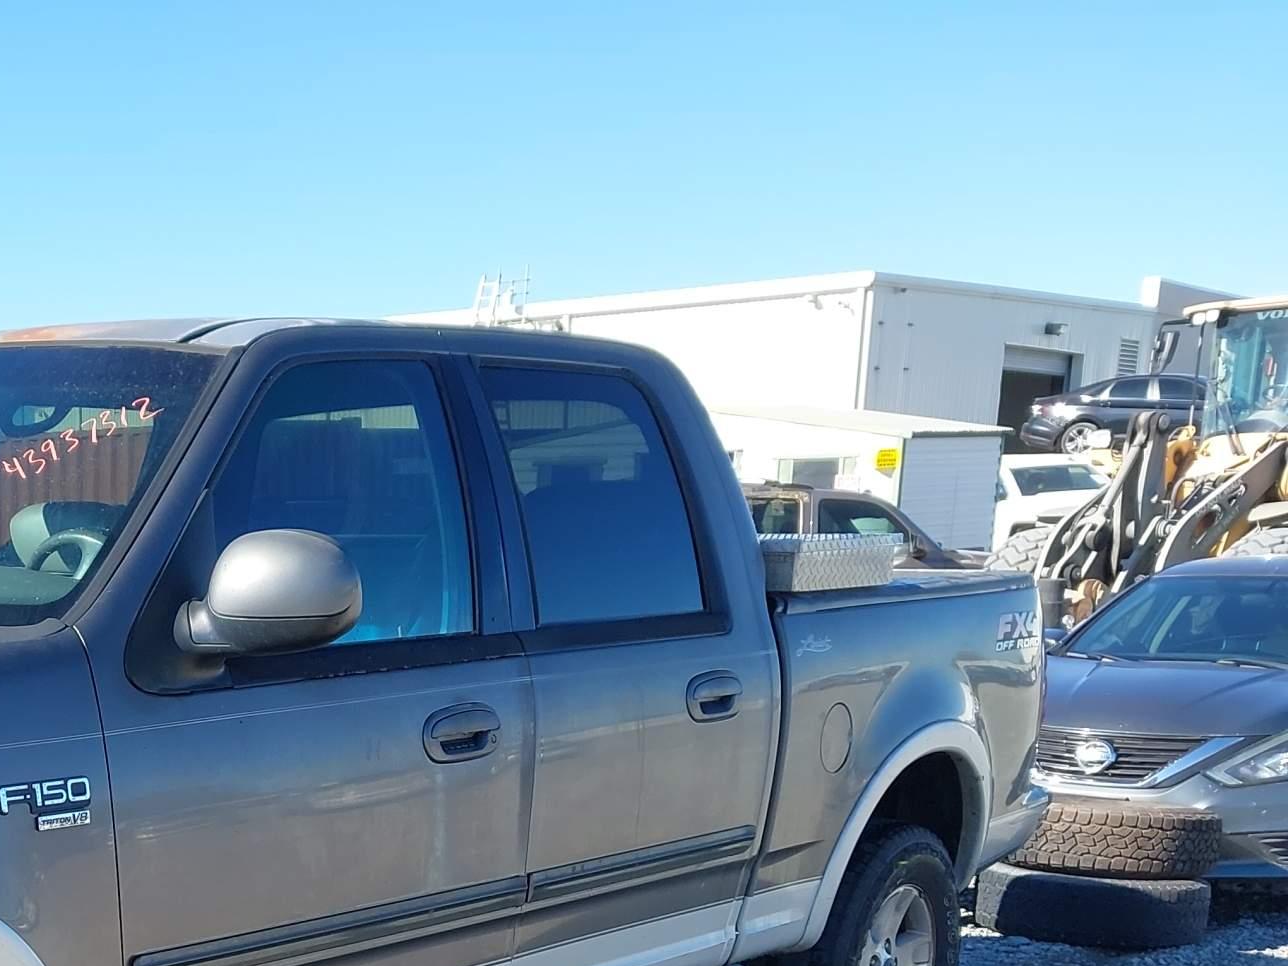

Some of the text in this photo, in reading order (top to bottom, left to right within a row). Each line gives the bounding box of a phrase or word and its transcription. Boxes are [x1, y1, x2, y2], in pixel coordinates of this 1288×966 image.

[2, 397, 164, 479] 43937312
[996, 639, 1015, 652] OFF
[72, 811, 88, 825] V8
